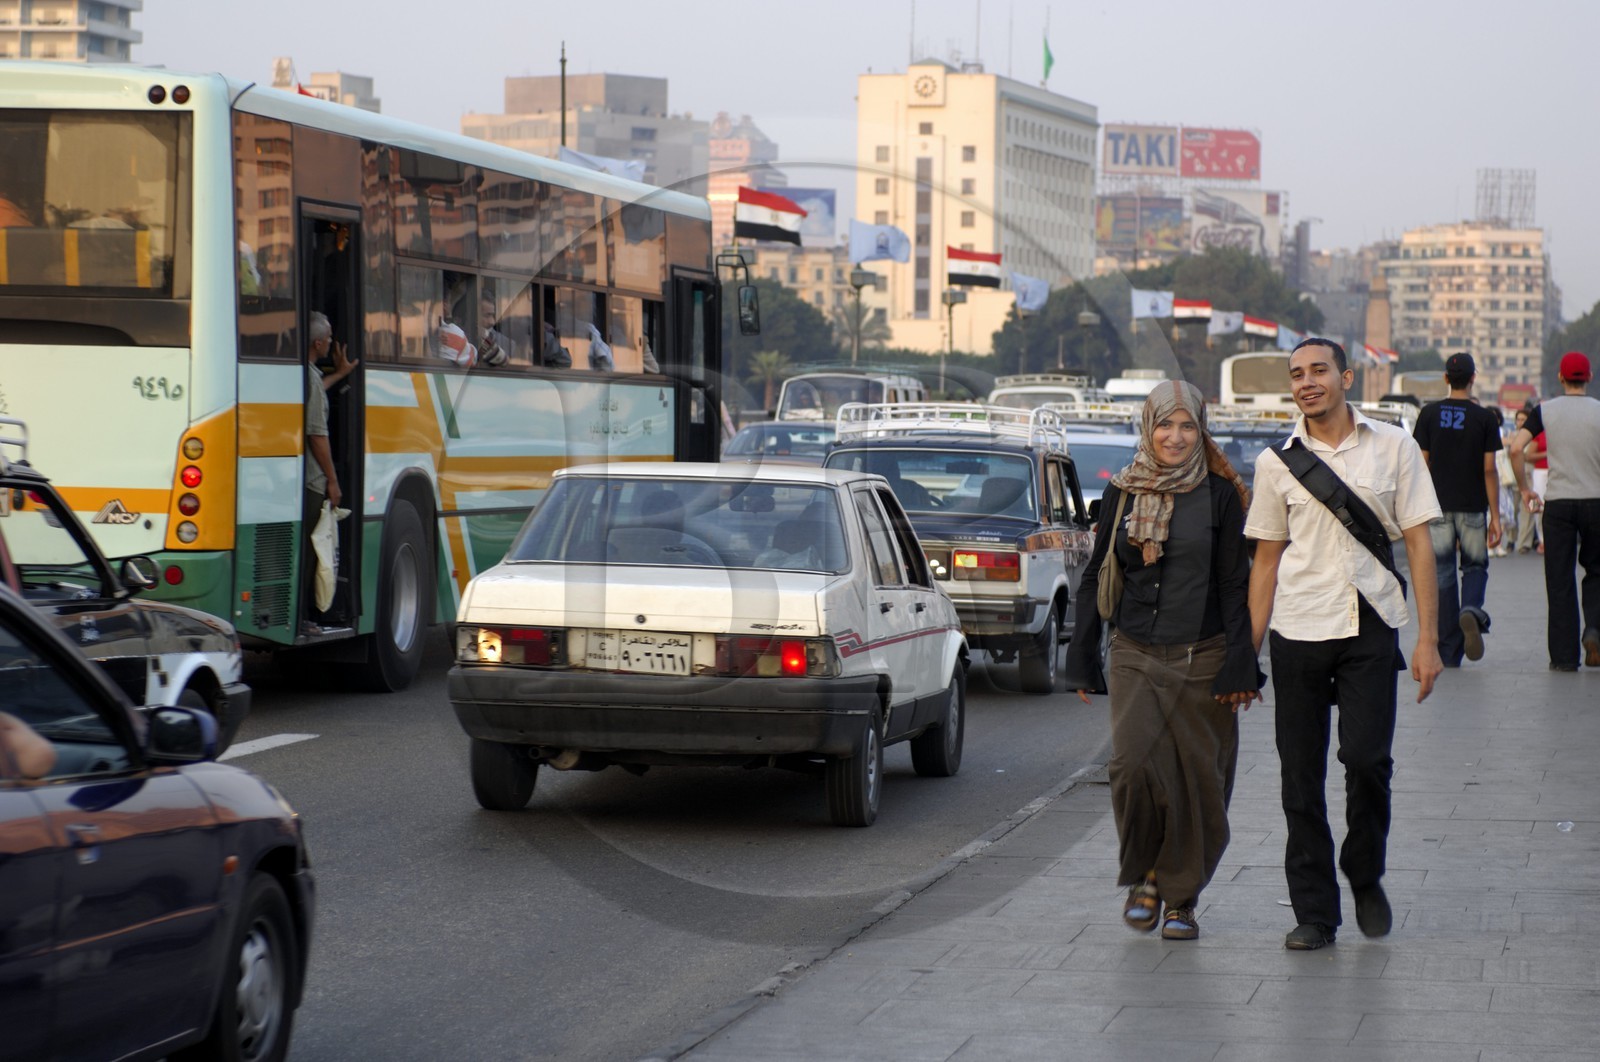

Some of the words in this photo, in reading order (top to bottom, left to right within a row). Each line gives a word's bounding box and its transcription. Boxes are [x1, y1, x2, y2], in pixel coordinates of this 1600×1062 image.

[1107, 133, 1175, 166] TAKI
[1440, 411, 1465, 429] 92
[599, 642, 607, 651] C
